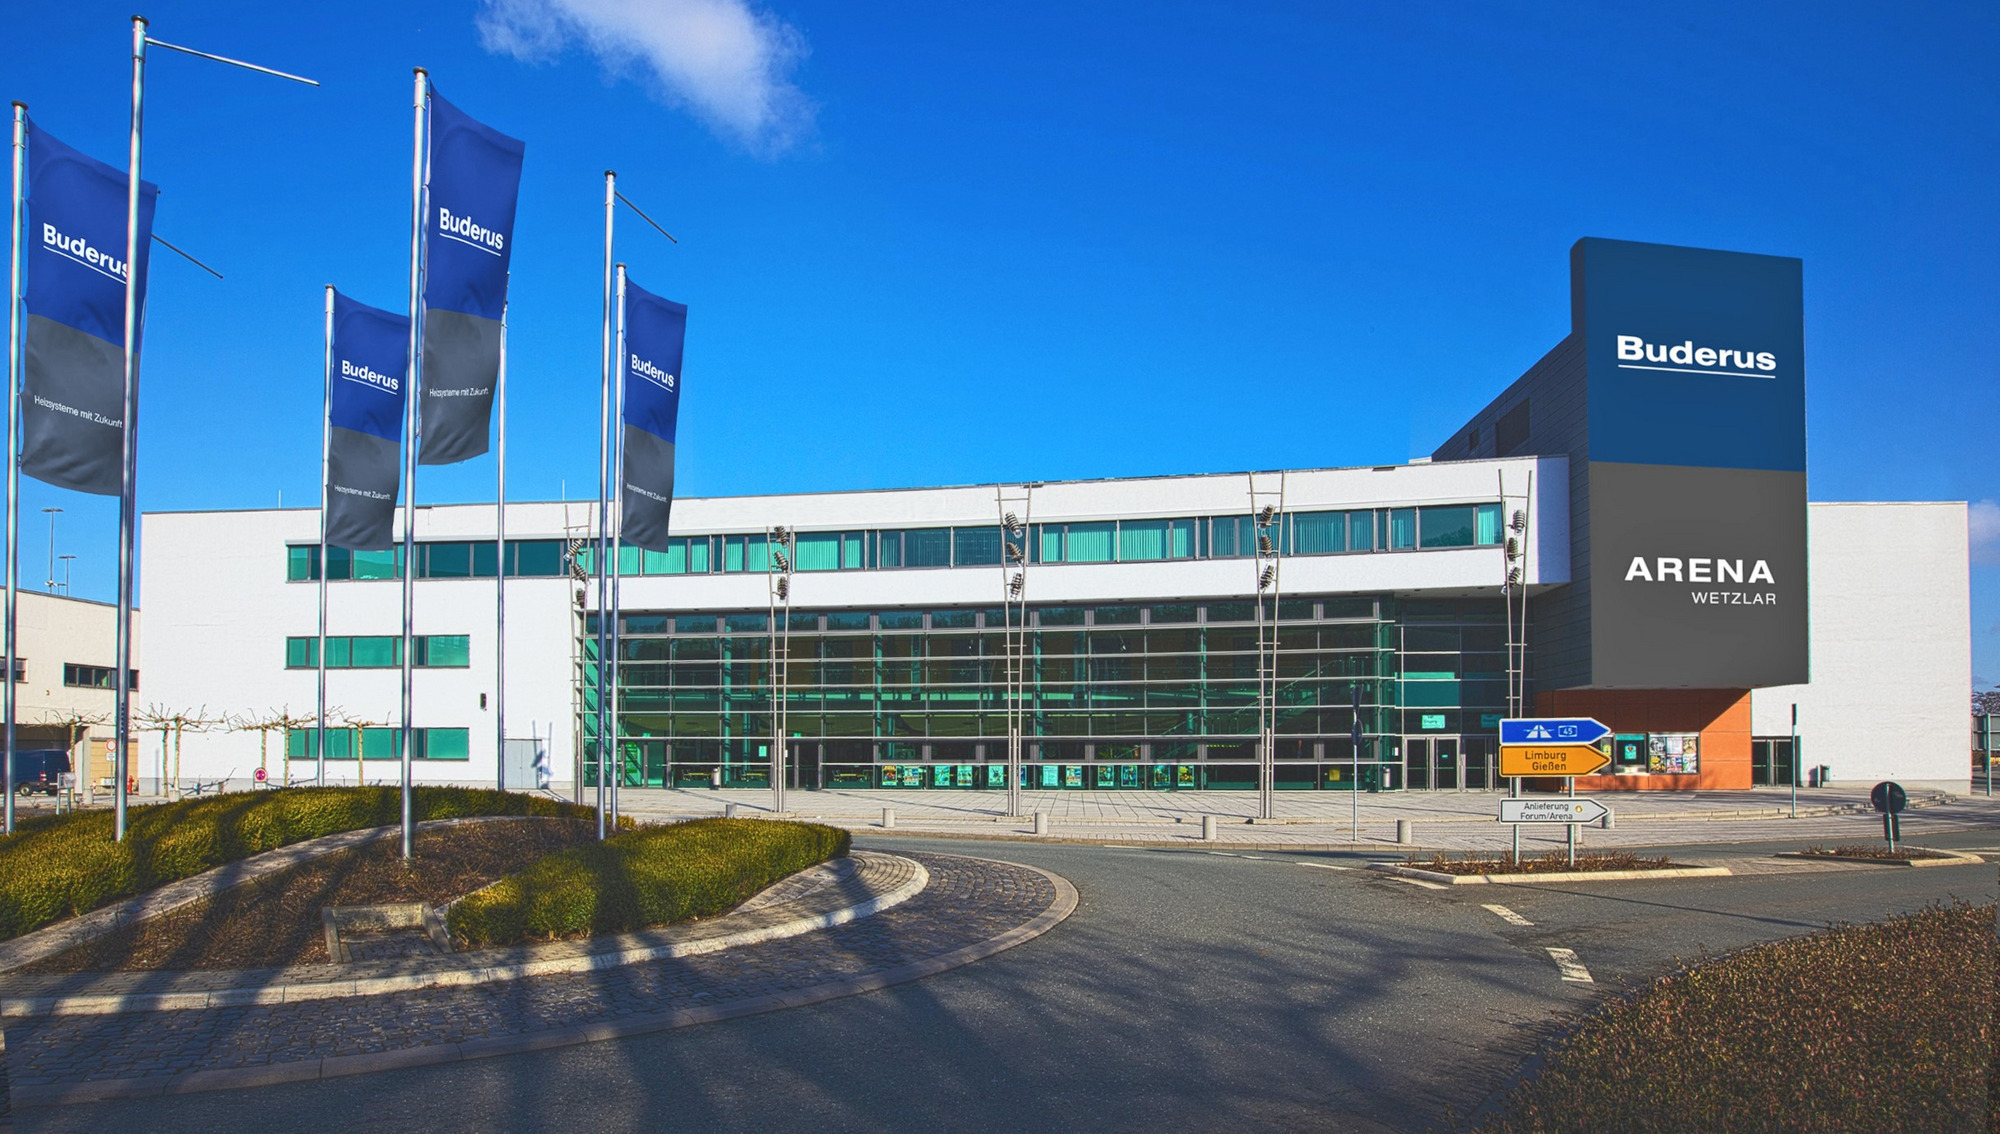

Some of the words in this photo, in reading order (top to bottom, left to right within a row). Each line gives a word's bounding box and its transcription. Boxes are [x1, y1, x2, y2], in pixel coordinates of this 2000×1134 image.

[439, 207, 504, 250] Buderus
[1617, 335, 1777, 371] Buderus
[341, 360, 399, 390] Buderus
[631, 353, 675, 388] Buderus
[34, 395, 79, 416] Heizsysteme
[80, 410, 93, 421] mit
[94, 412, 123, 428] Zukunft
[1624, 556, 1775, 584] ARENA
[1691, 592, 1777, 605] WETZLAR
[1525, 751, 1567, 761] Limburg
[1532, 762, 1567, 771] Gießen
[1520, 812, 1573, 820] Forum/Arena
[1524, 803, 1569, 811] Anlieferung
